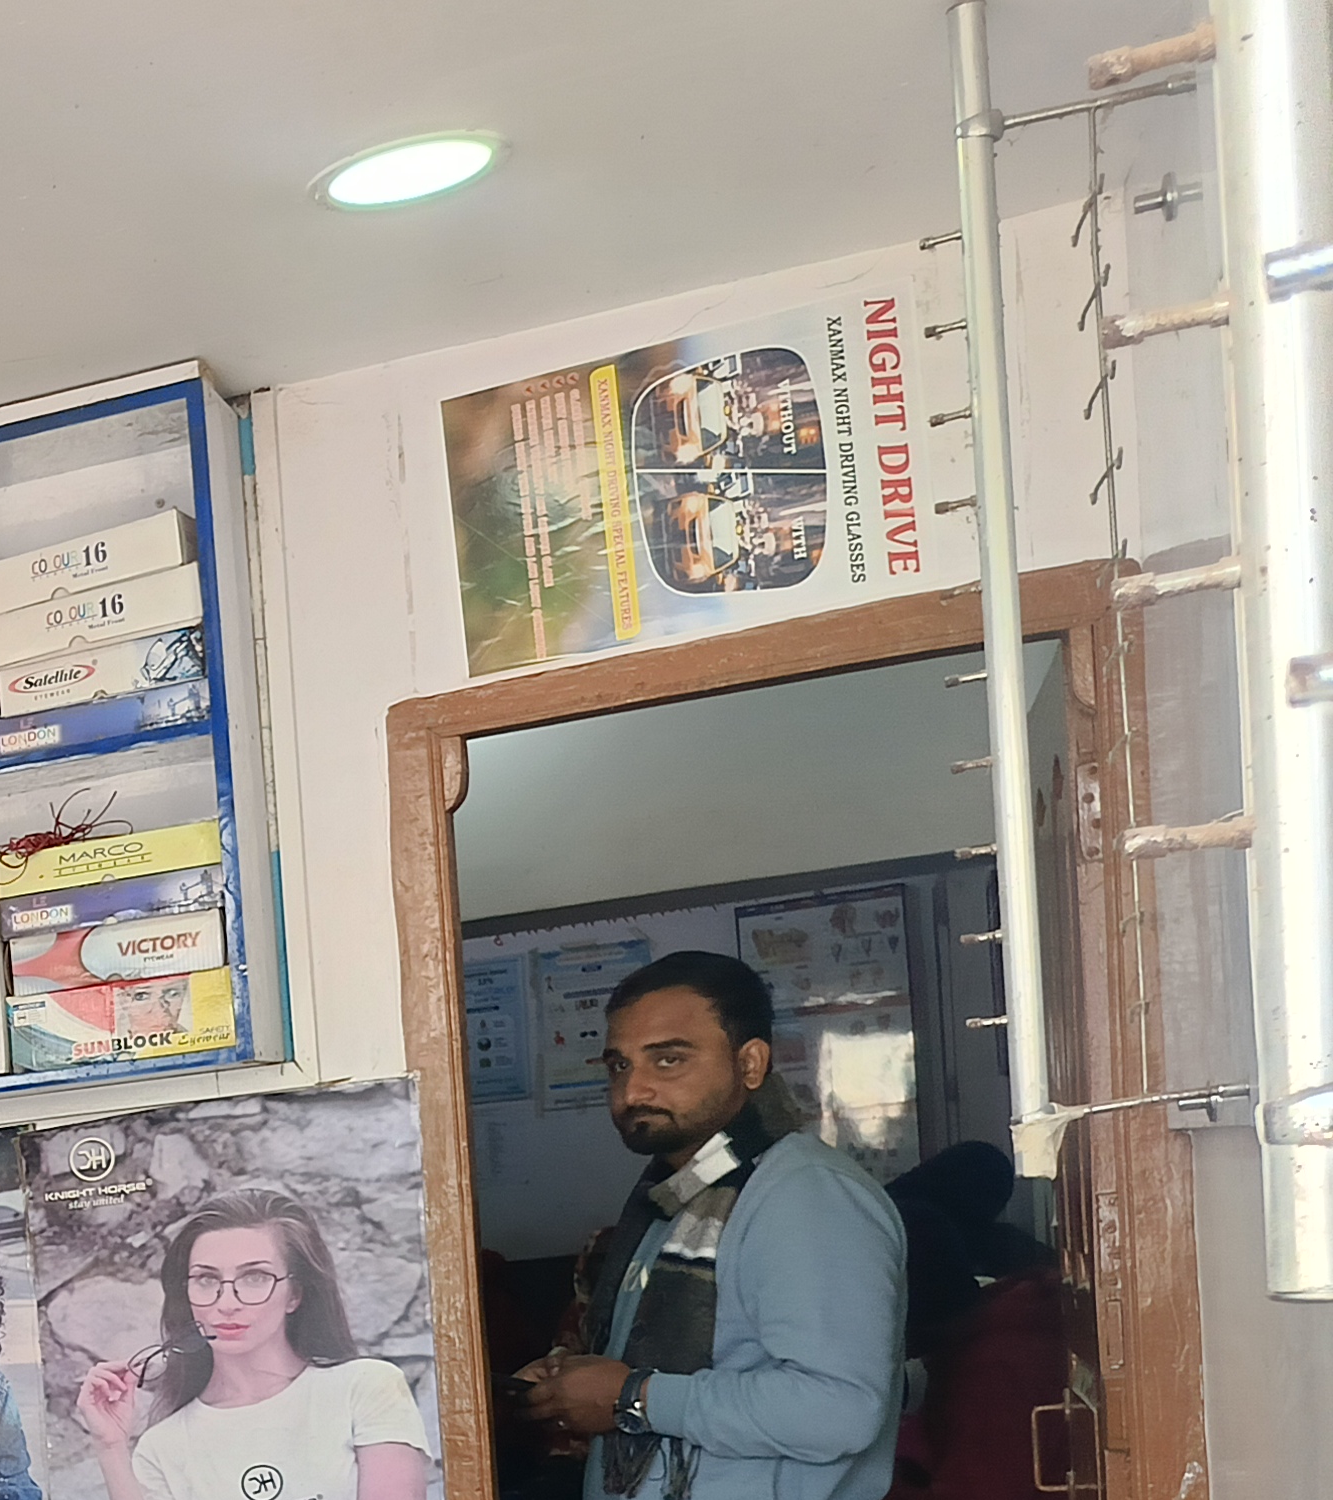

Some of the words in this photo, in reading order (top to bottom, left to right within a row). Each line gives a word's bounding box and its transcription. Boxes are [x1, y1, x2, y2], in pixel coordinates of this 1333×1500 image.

[826, 316, 847, 383] XANMAX
[863, 297, 907, 432] NIGHT
[778, 379, 797, 455] WITHOUT
[833, 388, 853, 436] NIGHT
[839, 442, 859, 507] DRIVING
[877, 443, 921, 576] DRIVE
[792, 516, 807, 560] WITH
[845, 511, 866, 583] GLASSES
[83, 541, 107, 567] 16
[99, 594, 123, 618] 16
[23, 669, 81, 690] Satellite
[34, 689, 70, 700] EYEWEAR
[1, 728, 56, 747] LONDON
[58, 841, 144, 866] MARCO
[13, 905, 70, 925] LONDON
[117, 930, 202, 957] VICTORY
[71, 1031, 173, 1058] SUNBLOCK
[44, 1188, 95, 1202] KNIGHT
[68, 1200, 90, 1210] stay
[93, 1194, 125, 1206] united
